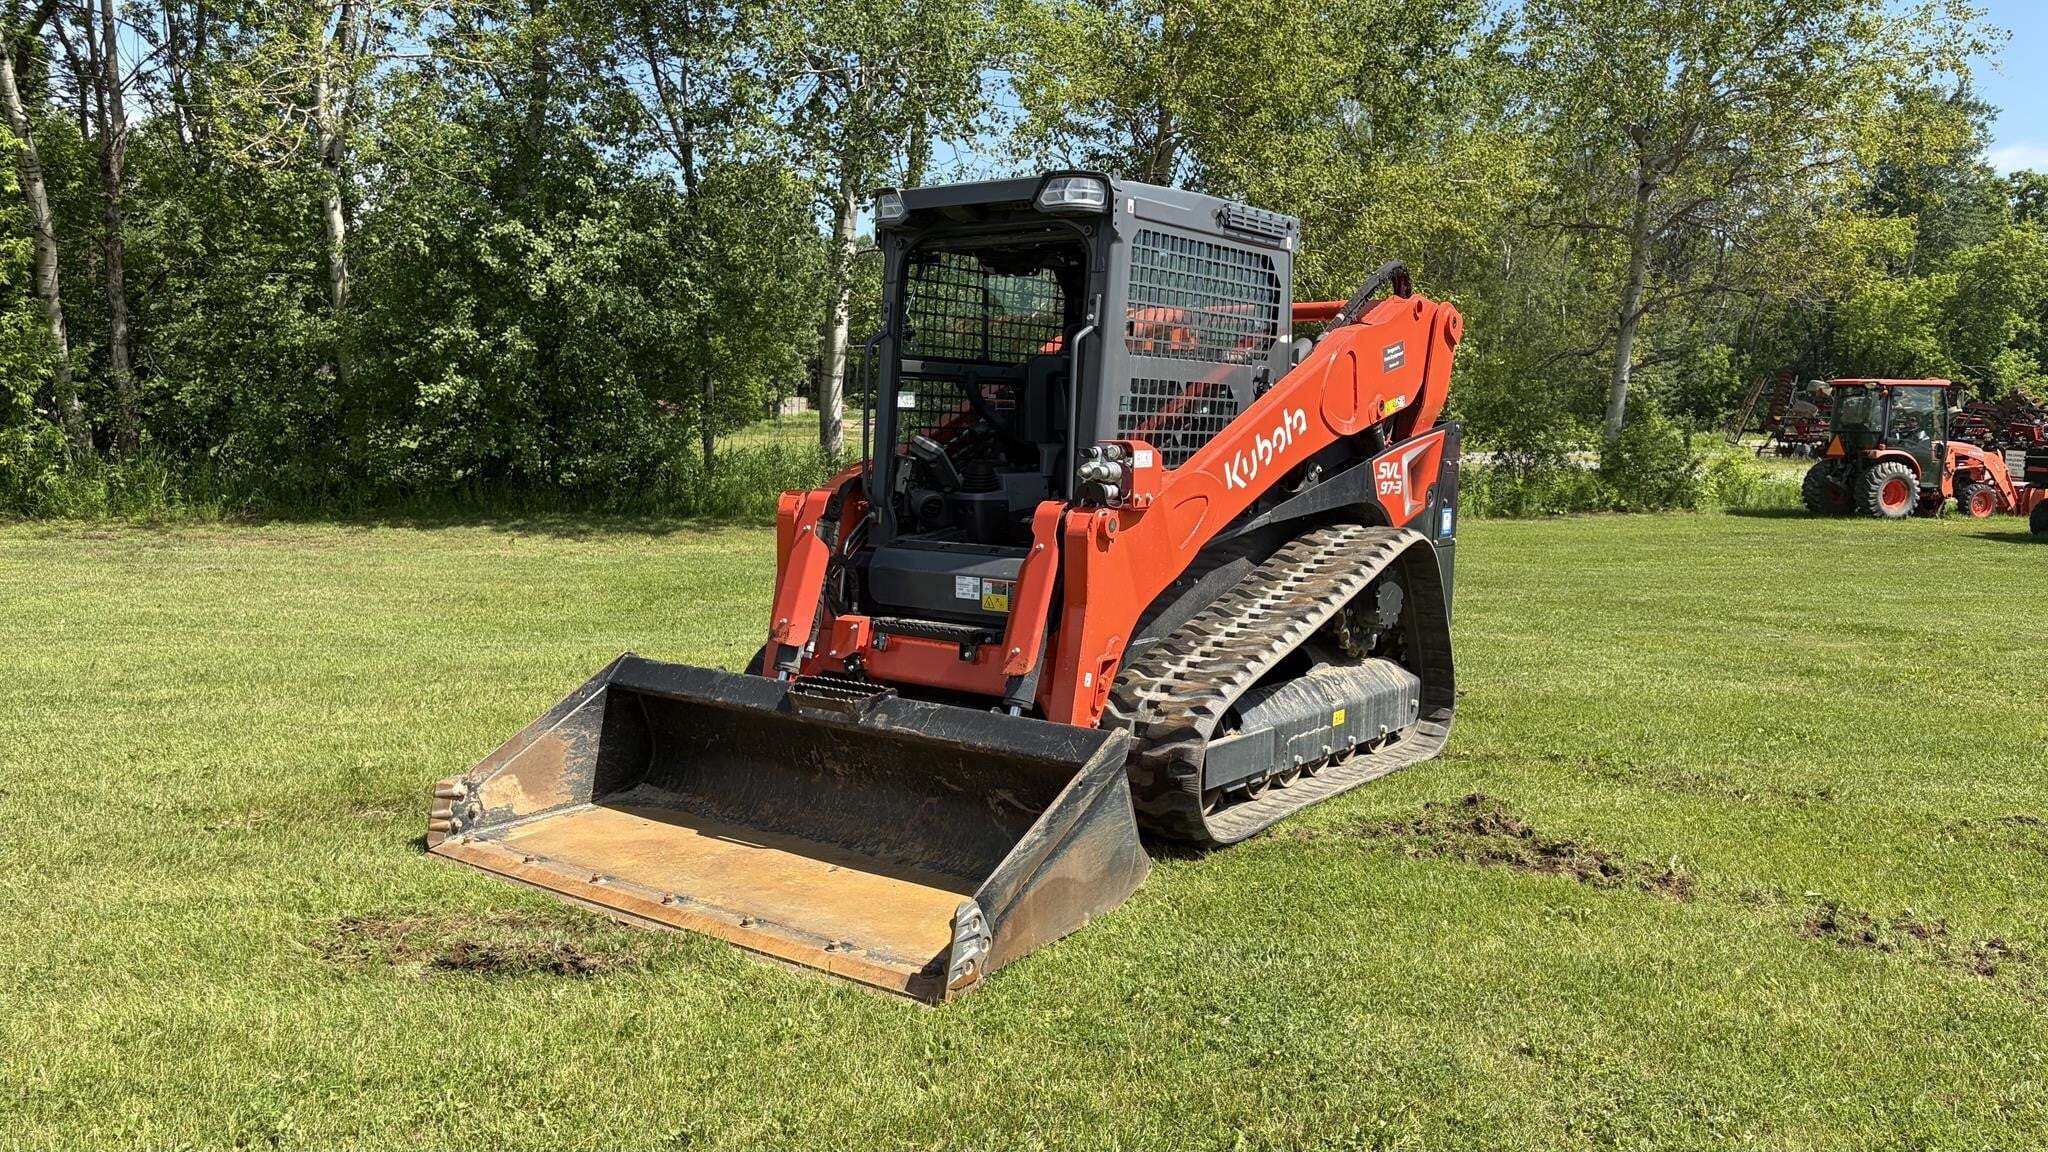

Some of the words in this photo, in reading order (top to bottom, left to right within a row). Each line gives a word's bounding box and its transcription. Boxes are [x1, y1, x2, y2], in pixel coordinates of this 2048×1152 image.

[1224, 408, 1307, 490] Kubota
[1377, 462, 1402, 480] SVL
[1379, 480, 1402, 495] 97-3
